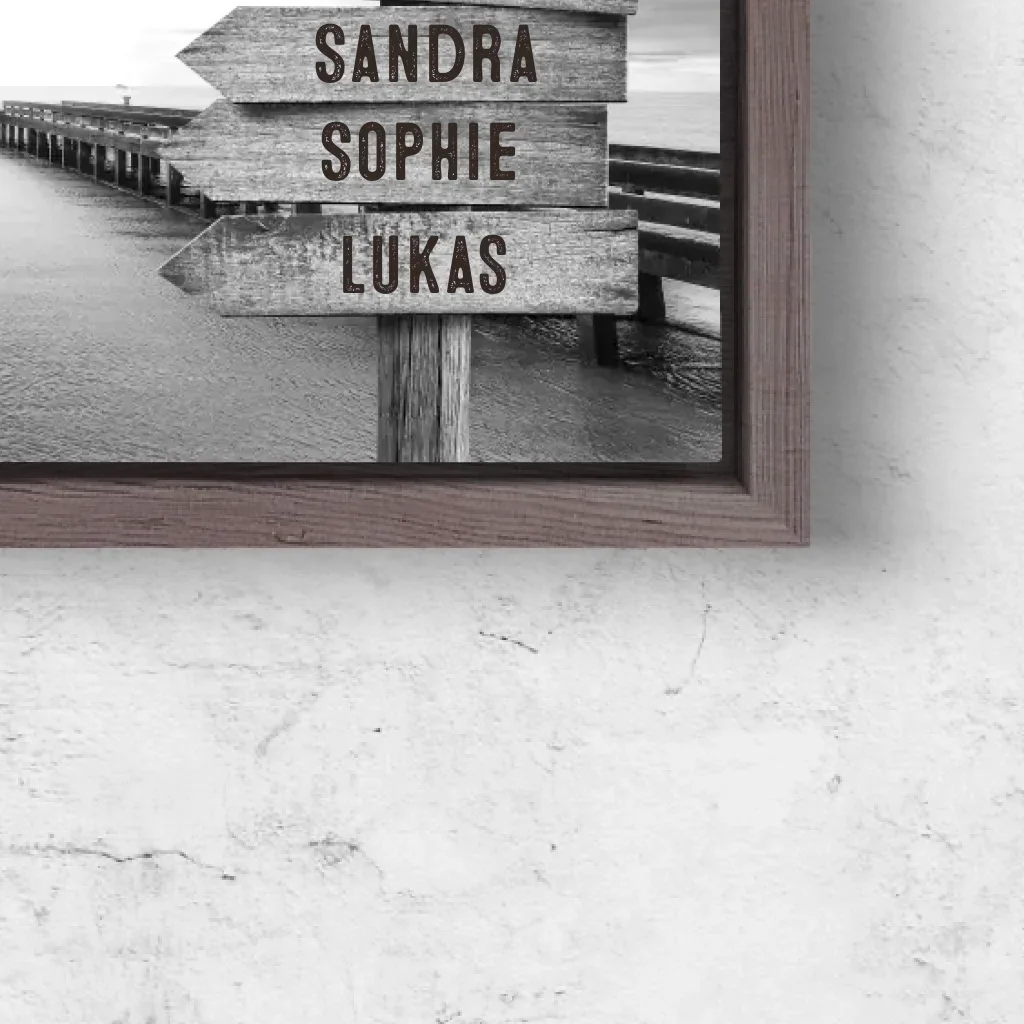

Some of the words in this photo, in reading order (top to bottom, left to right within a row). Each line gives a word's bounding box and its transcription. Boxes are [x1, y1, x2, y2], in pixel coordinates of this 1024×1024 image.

[315, 23, 538, 83] SANDRA
[321, 121, 517, 181] SOPHIE
[342, 234, 508, 294] LUKAS
